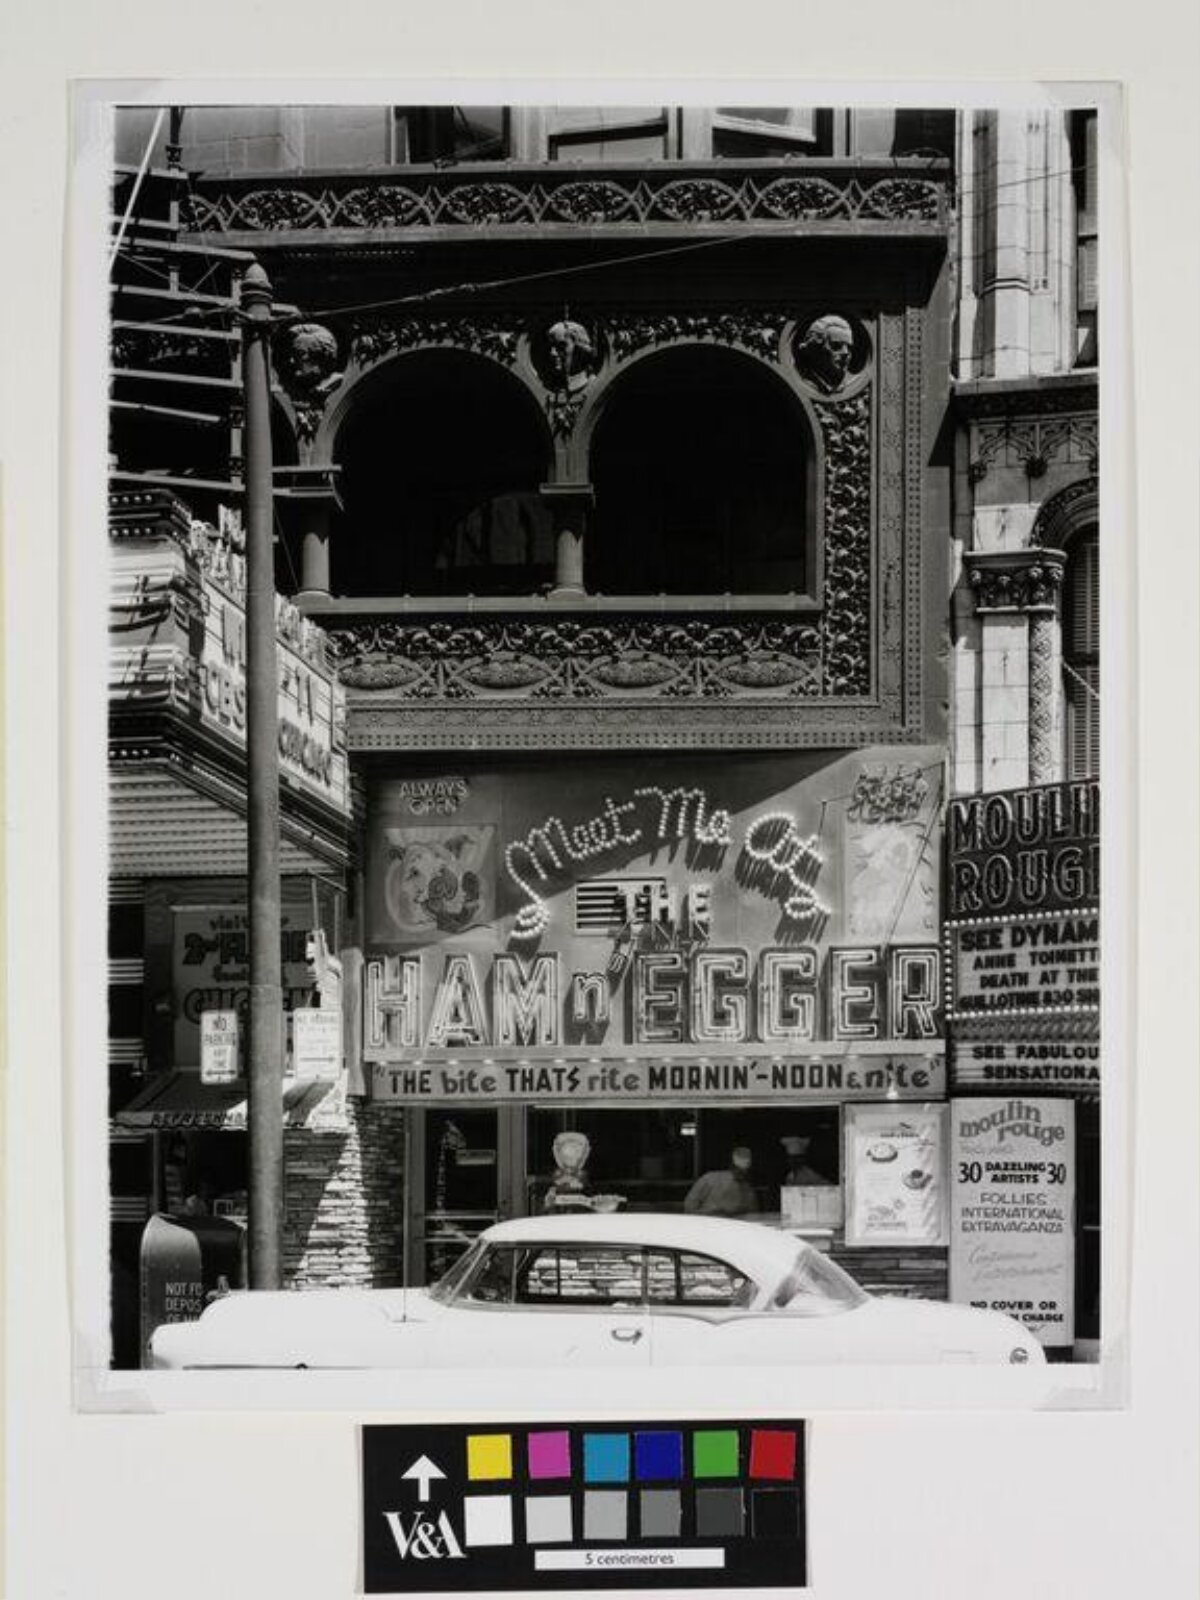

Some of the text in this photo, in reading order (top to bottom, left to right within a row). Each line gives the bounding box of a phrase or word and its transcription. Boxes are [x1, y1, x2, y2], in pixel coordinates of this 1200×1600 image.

[400, 778, 469, 799] ALWAYS
[409, 796, 457, 815] OPEN
[505, 798, 642, 938] Meet
[634, 786, 733, 845] Me
[619, 884, 714, 924] THE
[961, 920, 1098, 951] SEE DYNAM
[980, 968, 1099, 989] DEATH AT THE
[364, 952, 562, 1048] HAM
[633, 945, 943, 1046] EGGER
[972, 1045, 1099, 1059] SEE FABULOU
[441, 1067, 497, 1094] bite
[588, 1067, 640, 1092] rite
[983, 1065, 1099, 1080] SENSATIONA
[960, 1100, 1041, 1138] moulin
[997, 1122, 1065, 1147] rouge
[958, 1161, 1066, 1184] 30 DAZZLING 30
[991, 1173, 1039, 1184] ARTISTS
[980, 1193, 1047, 1206] FOLLIES
[961, 1207, 1064, 1220] INTERNATIONAL
[961, 1221, 1063, 1233] EXTRAVAGANZA
[165, 1282, 187, 1296] NOT
[970, 1300, 1057, 1310] NO COVER OR
[1022, 1313, 1064, 1322] CHARGE
[382, 1509, 469, 1560] V&A
[585, 1551, 675, 1565] 5 centimetres
